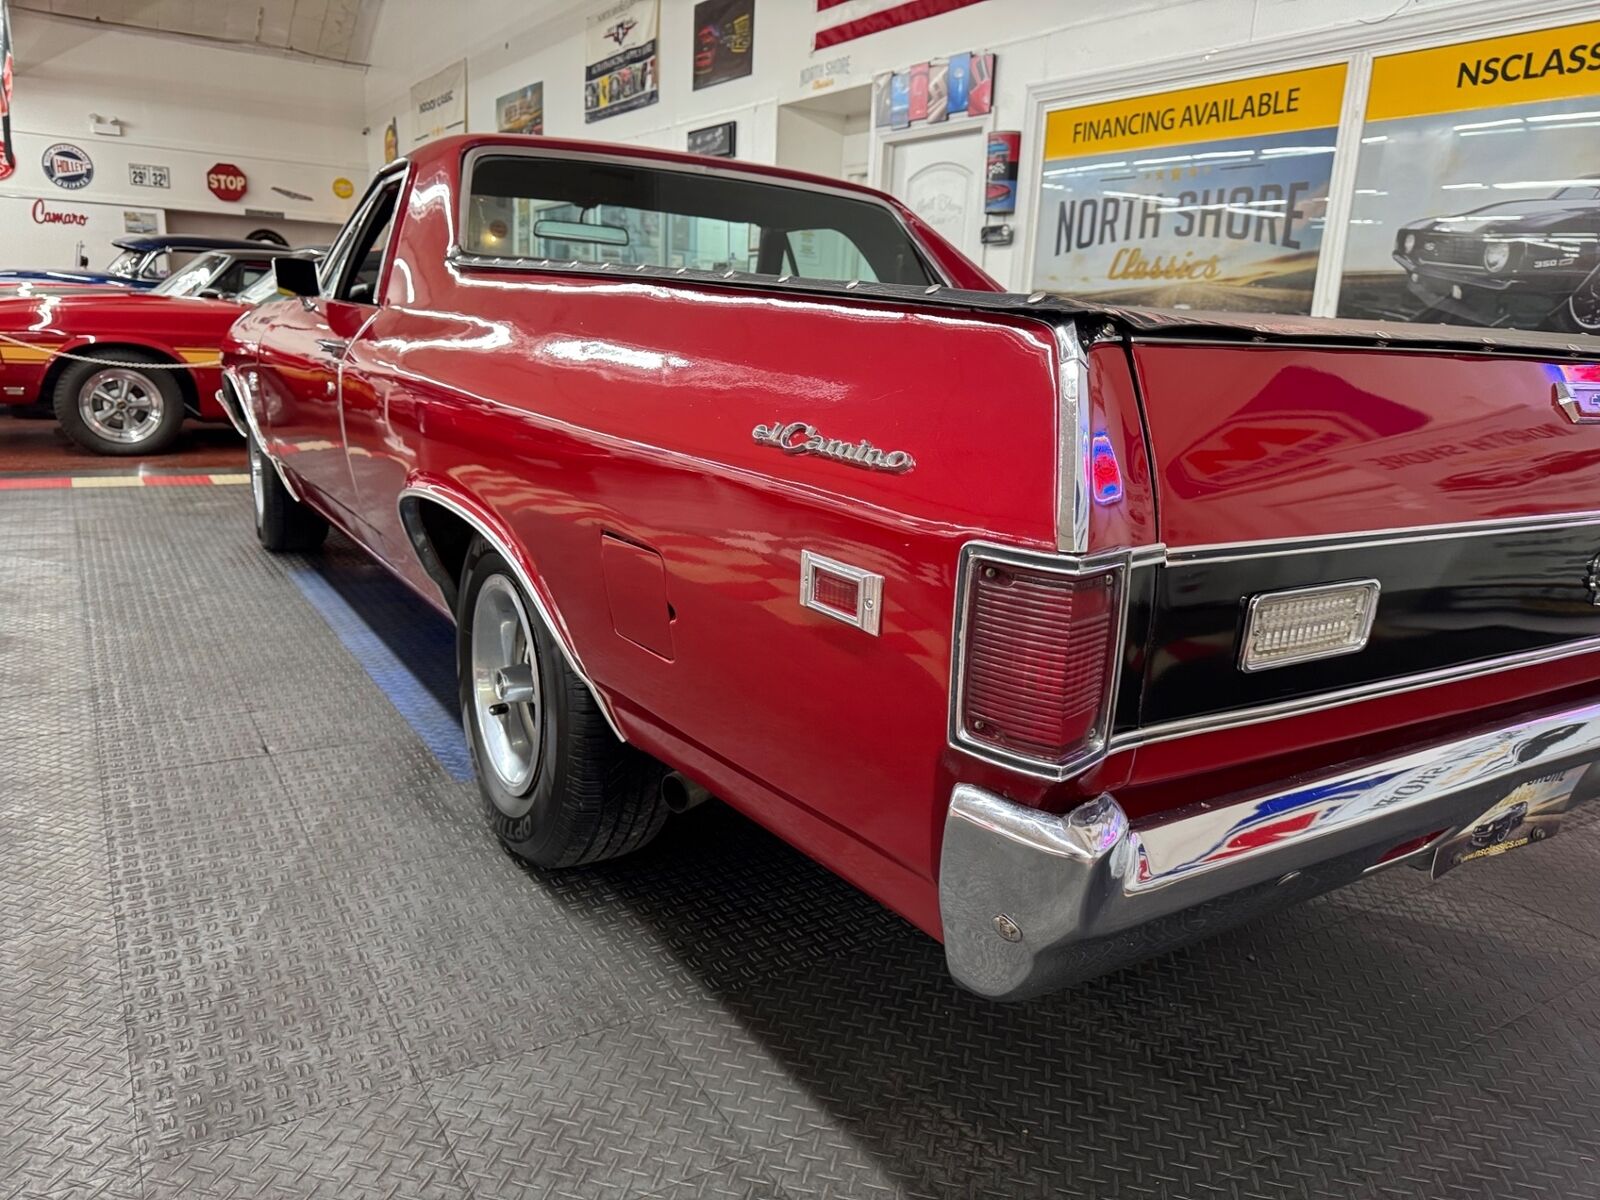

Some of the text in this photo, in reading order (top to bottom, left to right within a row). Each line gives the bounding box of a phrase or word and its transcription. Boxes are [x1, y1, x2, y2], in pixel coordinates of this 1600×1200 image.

[1072, 87, 1301, 144] FINANCING AVAILABLE
[55, 158, 84, 174] HOLLEY
[207, 173, 247, 192] STOP
[32, 198, 89, 226] Camaro
[1055, 181, 1310, 257] NORTH SHORE
[1107, 247, 1222, 281] Classics
[1533, 258, 1558, 270] 350
